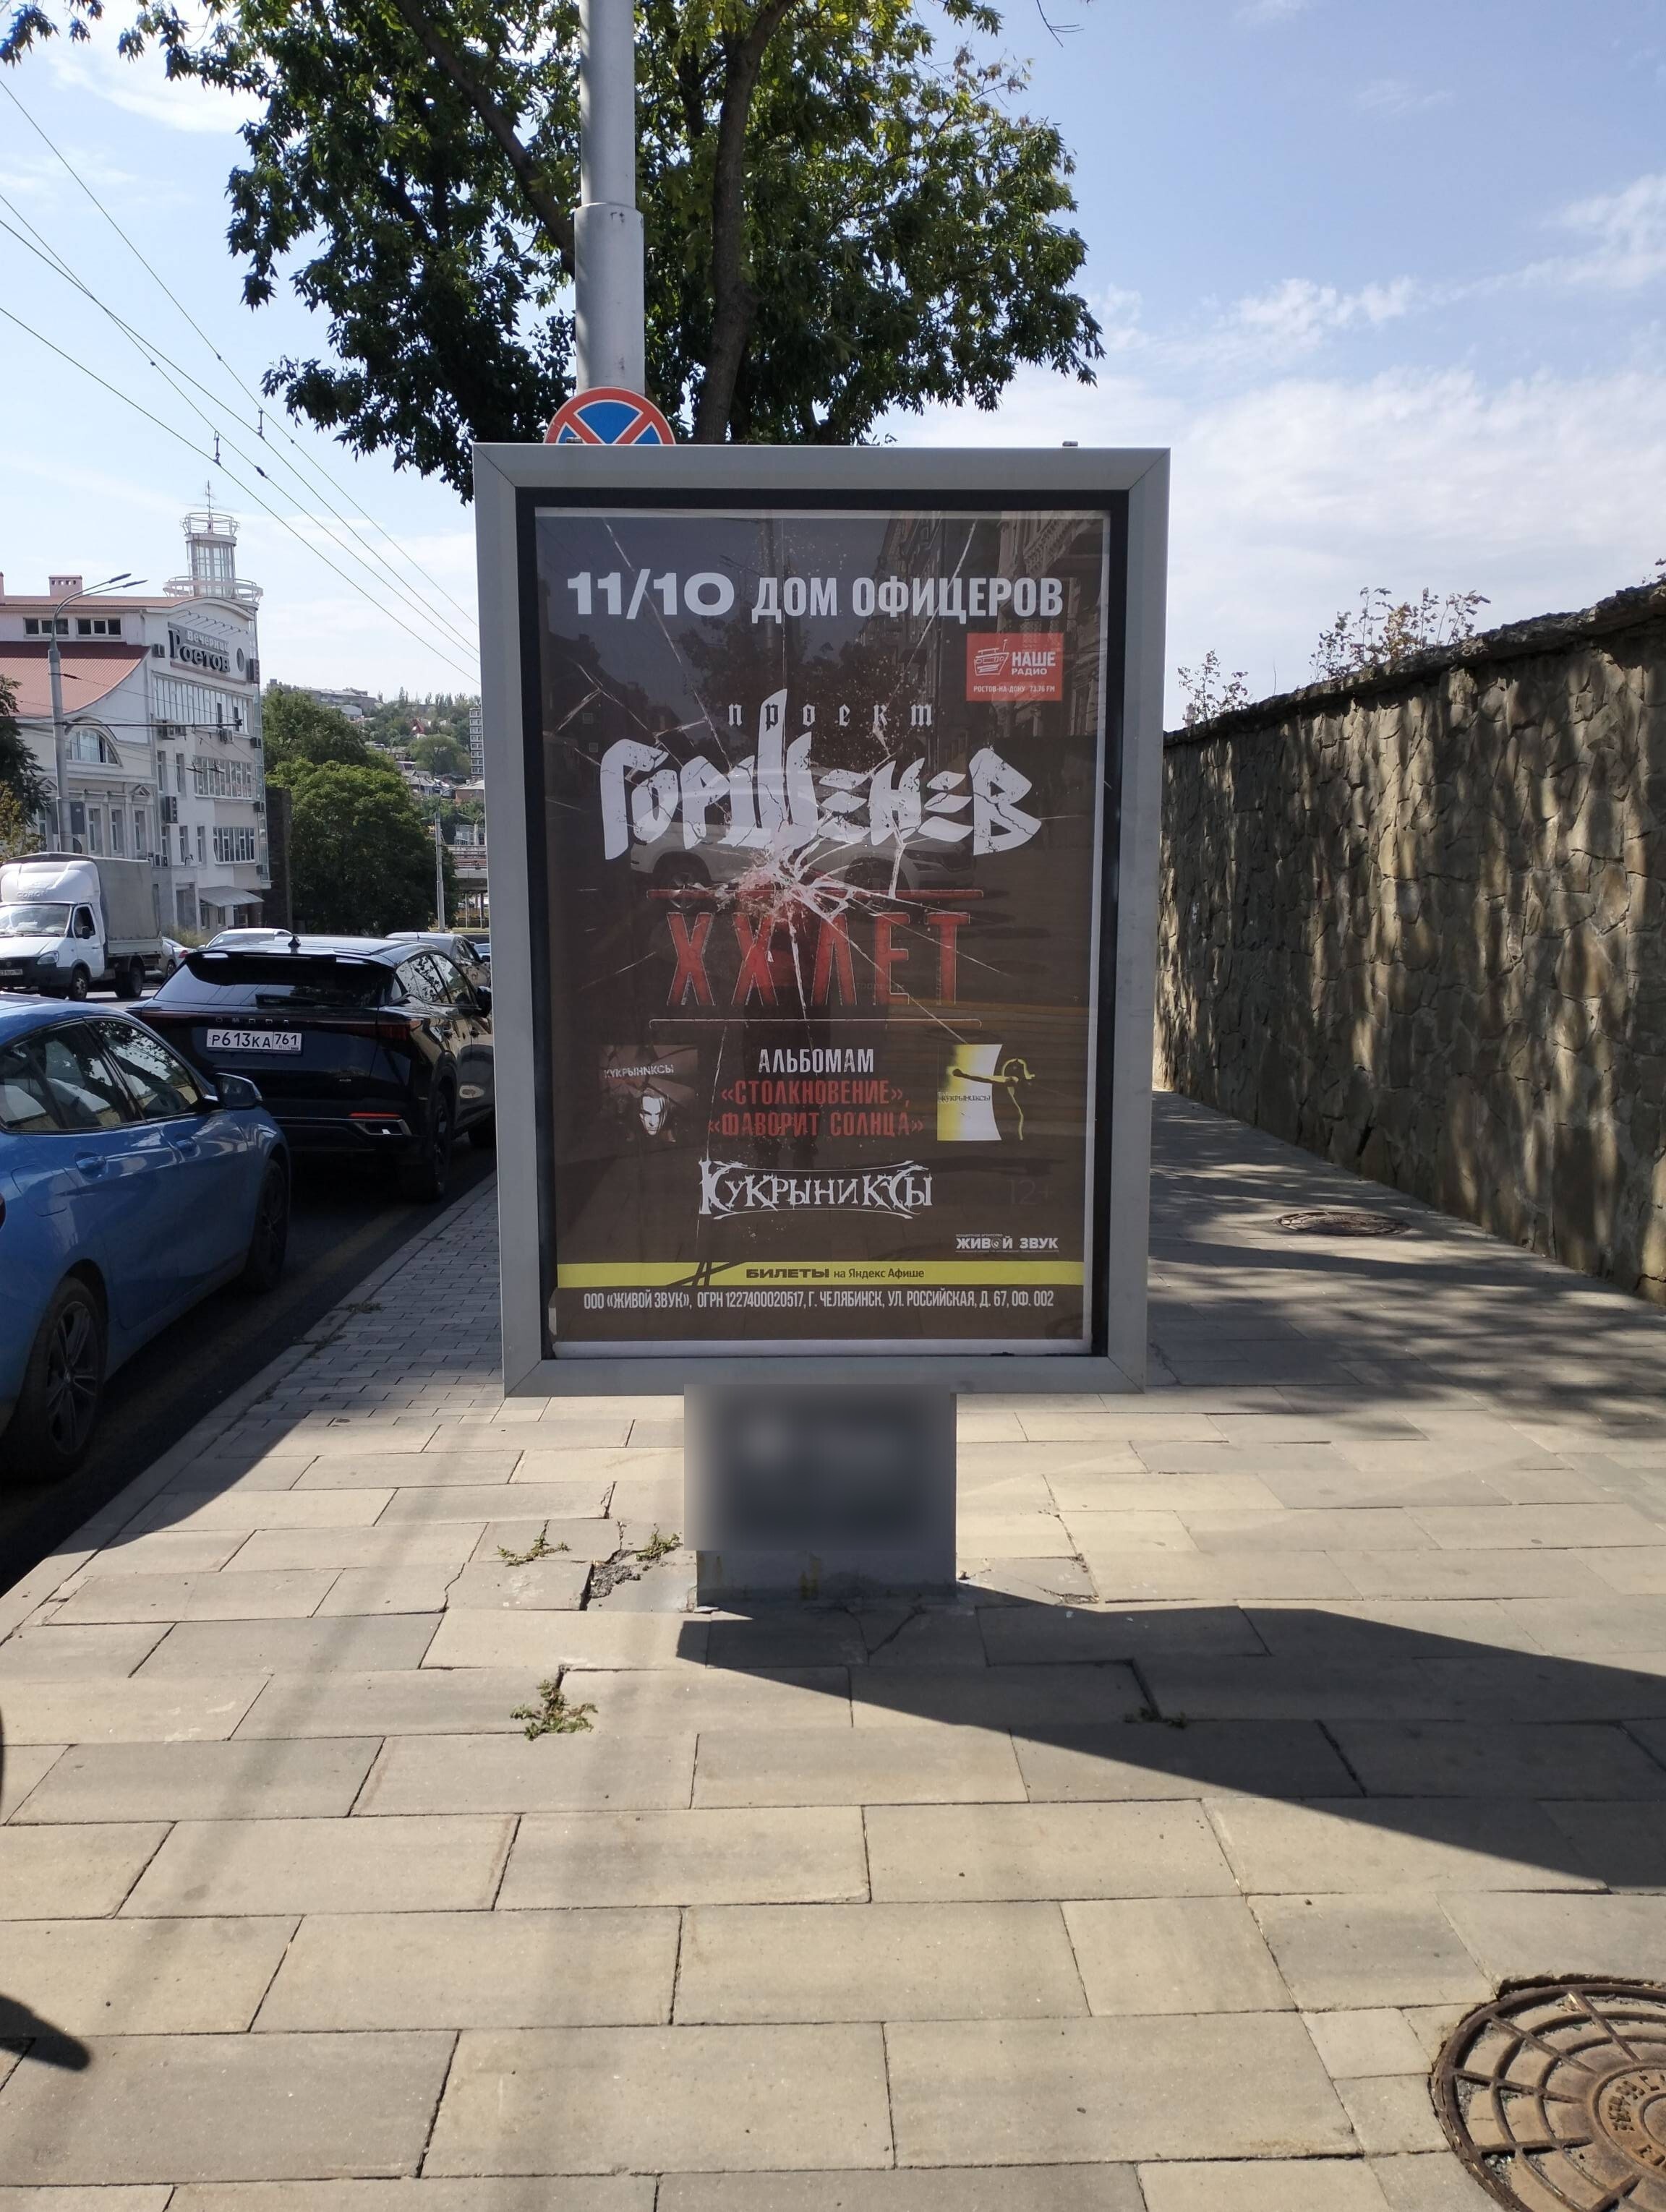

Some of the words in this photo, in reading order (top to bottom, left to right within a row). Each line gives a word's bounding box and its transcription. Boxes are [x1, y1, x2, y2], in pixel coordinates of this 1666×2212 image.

[568, 568, 735, 620] 11/10
[751, 576, 839, 625] ДОМ
[853, 576, 1064, 625] ОФИЦЕРОВ
[1012, 651, 1056, 667] НАШЕ
[1011, 667, 1048, 676] РАДИО
[727, 702, 934, 732] проект
[811, 912, 970, 1006] ЛЕТ
[275, 1033, 298, 1045] 761
[759, 1048, 874, 1073] АЛЬБОМАМ
[830, 1111, 925, 1137] СОЛНЦА»
[1019, 1237, 1059, 1249] ЗВУК
[746, 1268, 830, 1279] БИЛЕТЫ
[848, 1268, 886, 1280] Яндекс
[887, 1267, 925, 1280] Афише
[584, 1293, 605, 1309] ООО
[607, 1290, 652, 1309] «ЖИВОЙ
[697, 1291, 723, 1308] ОГРН
[820, 1290, 885, 1309] ЧЕЛЯБИНСК,
[887, 1290, 905, 1308] УЛ.
[907, 1287, 977, 1309] РОССИЙСКАЯ,
[1012, 1290, 1031, 1308] ОФ.
[1033, 1290, 1054, 1307] 002
